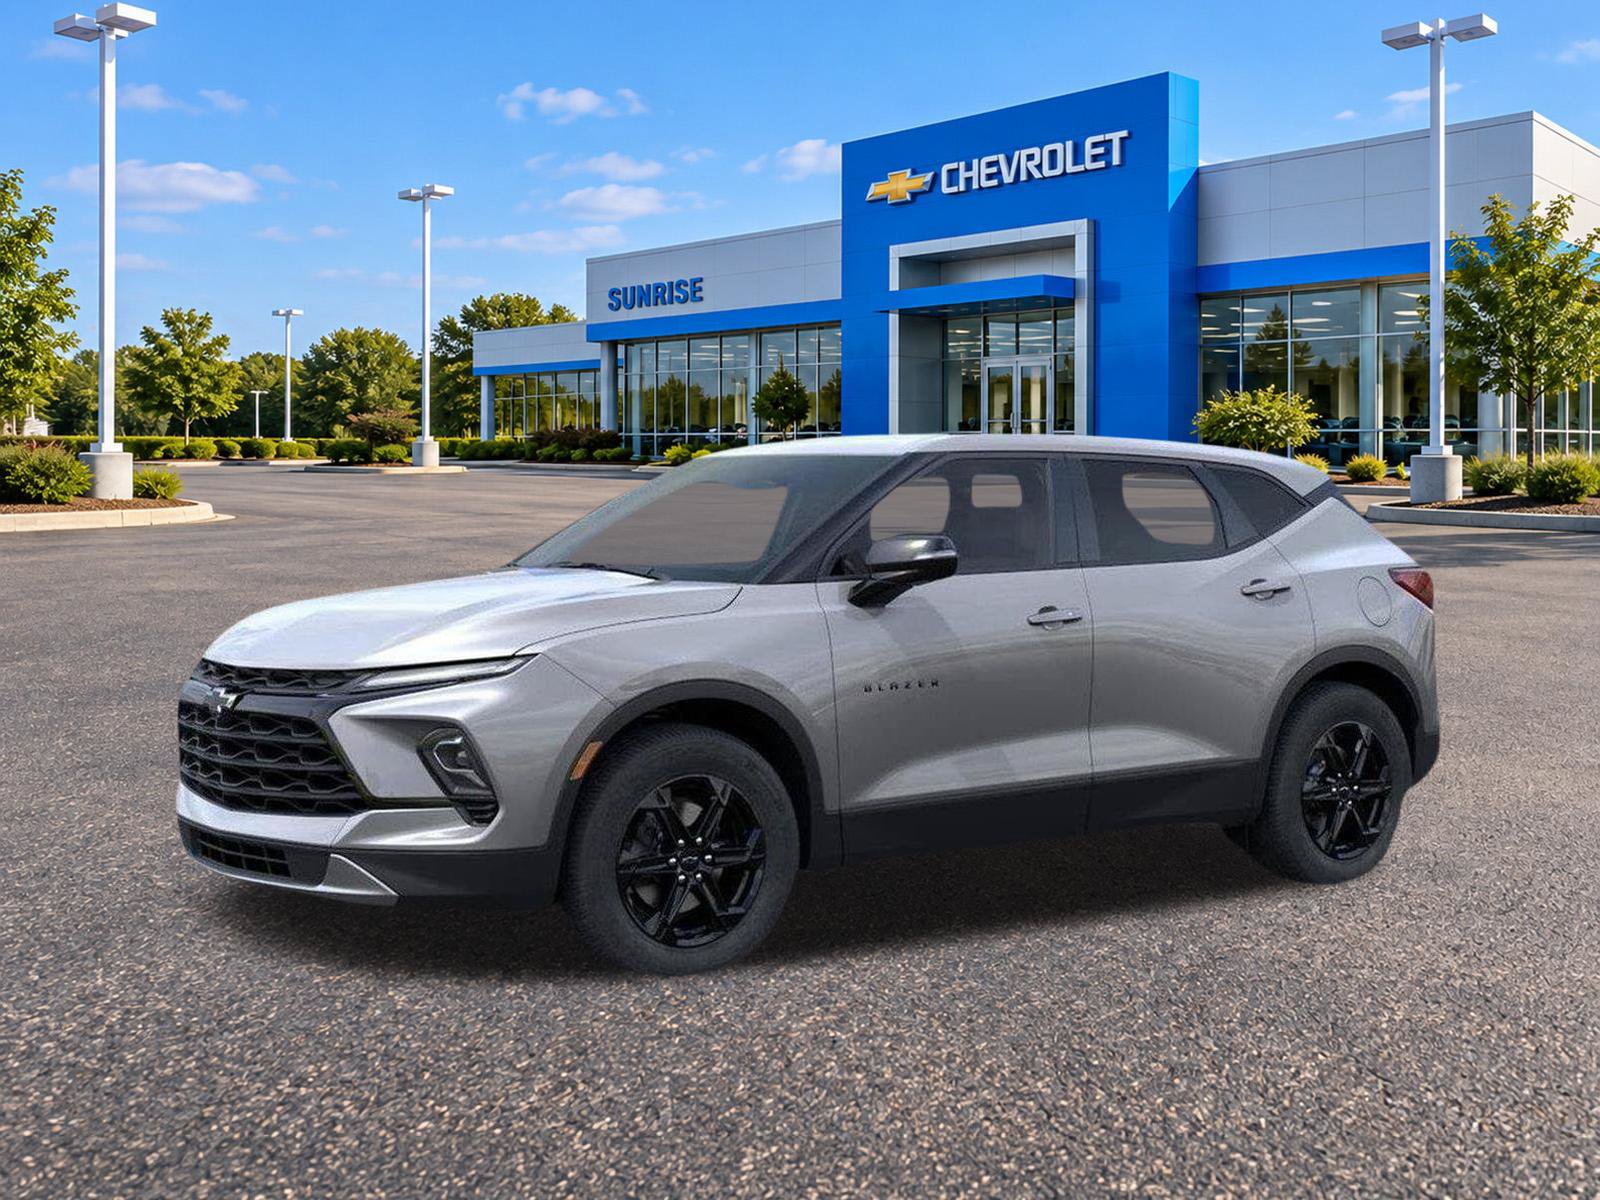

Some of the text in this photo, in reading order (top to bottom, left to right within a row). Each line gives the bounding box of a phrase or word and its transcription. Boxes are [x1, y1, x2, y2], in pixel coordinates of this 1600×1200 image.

[941, 130, 1129, 194] CHEVROLET
[608, 277, 704, 312] SUNRISE
[863, 680, 940, 693] BLAZER
